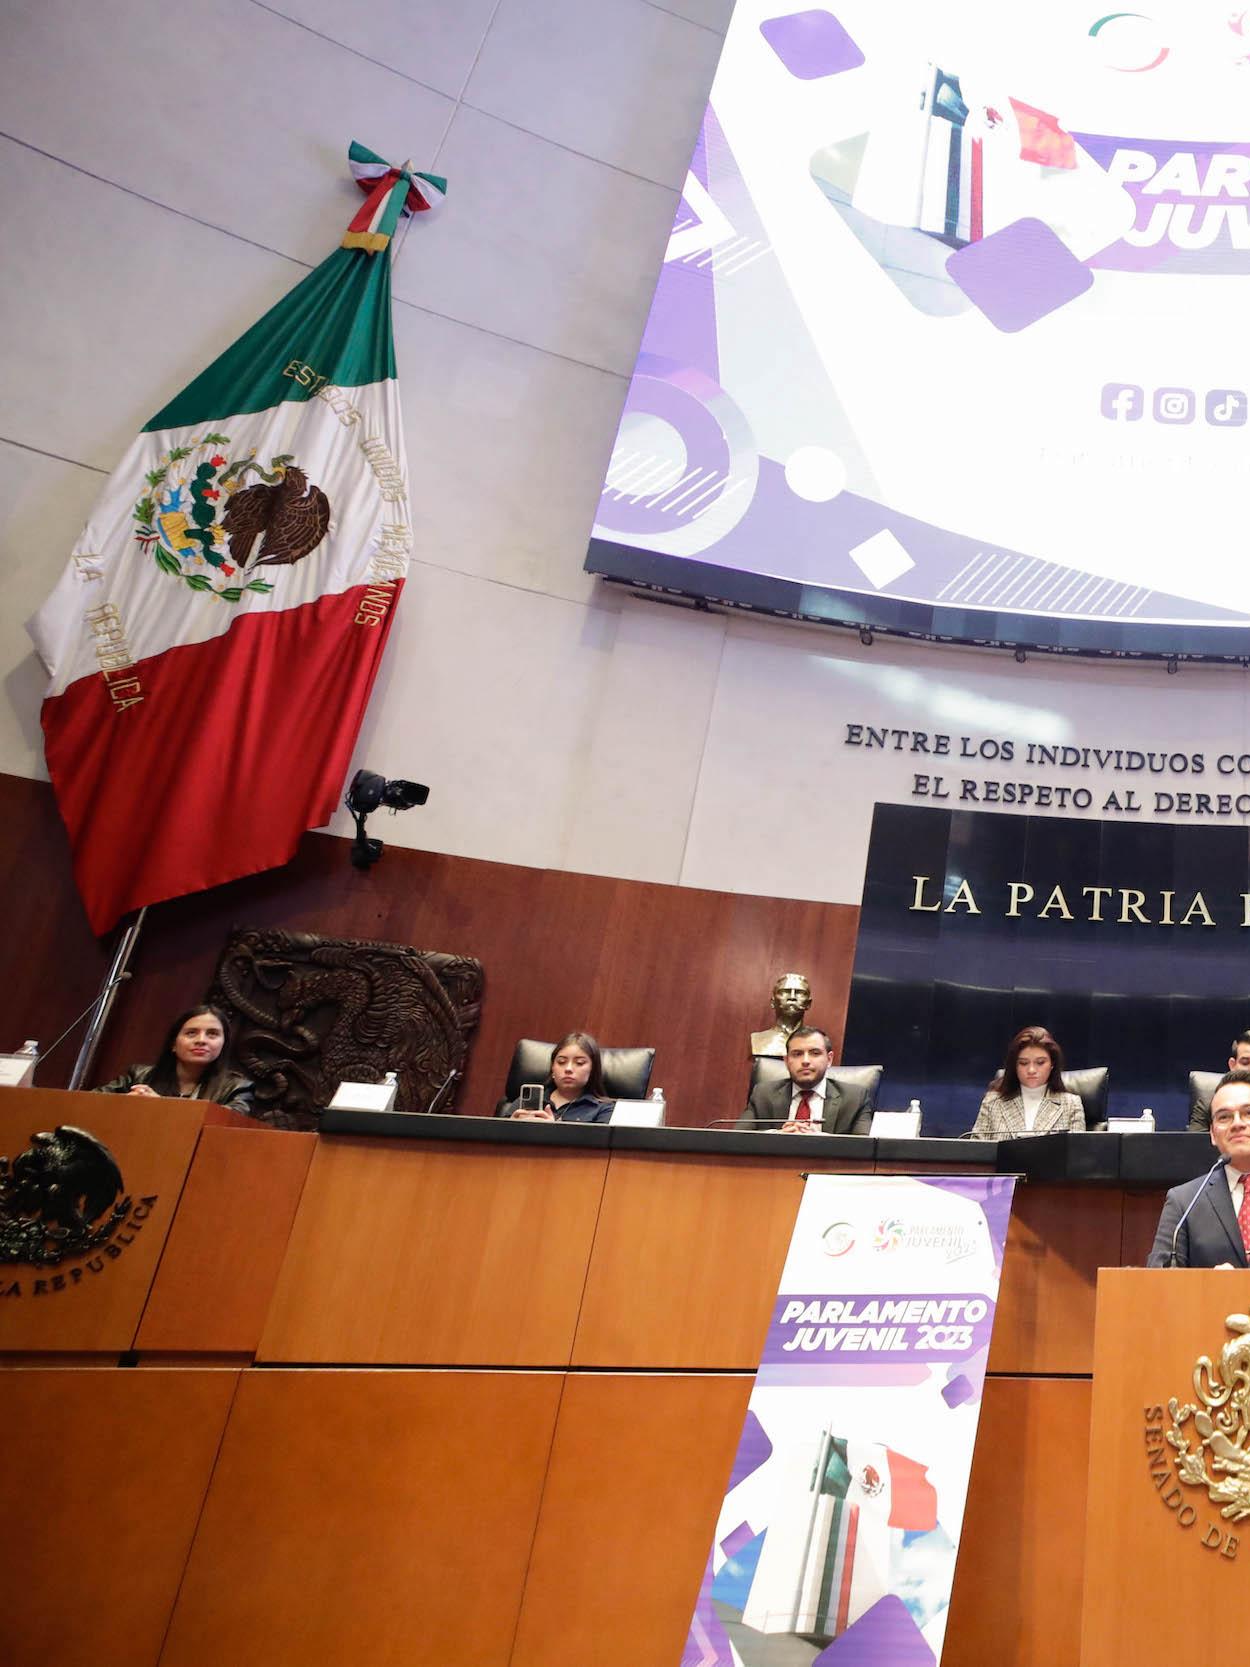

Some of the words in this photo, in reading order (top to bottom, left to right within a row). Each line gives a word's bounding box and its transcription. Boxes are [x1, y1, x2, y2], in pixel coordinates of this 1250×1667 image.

[283, 360, 362, 427] ESTDOS
[844, 723, 951, 755] ENTRE
[960, 737, 1015, 762] LOS
[1026, 743, 1205, 774] INDIVIDUOS
[912, 774, 950, 799] EL
[959, 779, 1093, 809] RESPETO
[1102, 790, 1142, 812] AL
[908, 875, 982, 915] LA
[1005, 881, 1216, 927] PATRIA
[32, 1194, 159, 1296] REPUBLICA
[780, 1300, 988, 1324] PARLAMENTO
[782, 1326, 908, 1352] JUVENIL
[914, 1324, 974, 1351] 2023
[1144, 1404, 1198, 1528] SENADO
[1201, 1522, 1240, 1559] DE
